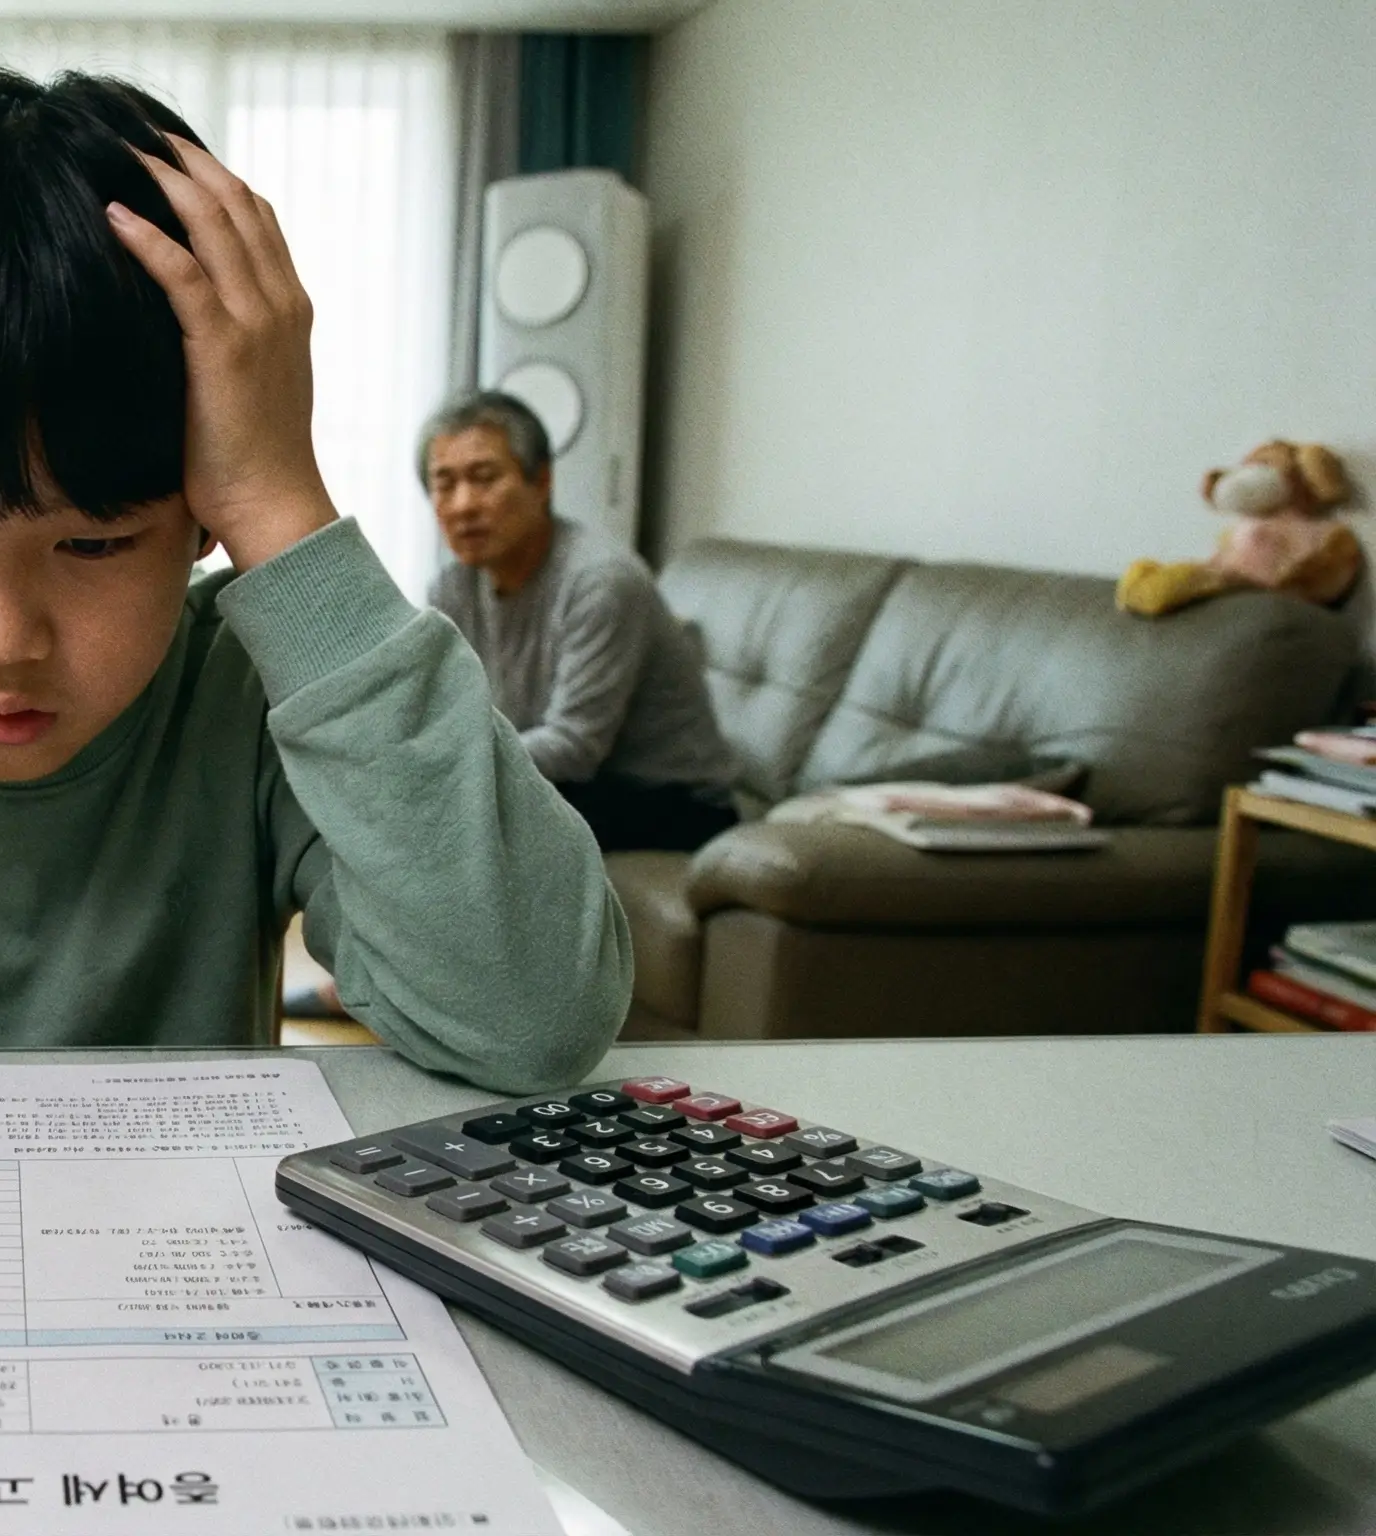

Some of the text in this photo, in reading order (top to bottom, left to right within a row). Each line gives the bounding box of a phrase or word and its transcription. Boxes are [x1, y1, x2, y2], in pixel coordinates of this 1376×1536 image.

[592, 1091, 615, 1103] 0
[533, 1103, 570, 1116] 00
[586, 1122, 614, 1134] 2
[691, 1127, 714, 1139] 4
[533, 1135, 561, 1147] 3
[639, 1141, 667, 1153] 5
[751, 1147, 774, 1159] 4
[584, 1156, 611, 1168] 6
[694, 1161, 725, 1174] 5
[814, 1167, 843, 1181] 7
[639, 1177, 669, 1190] 6
[756, 1183, 789, 1196] 8
[704, 1200, 733, 1213] 9
[62, 1472, 219, 1507] 증여세
